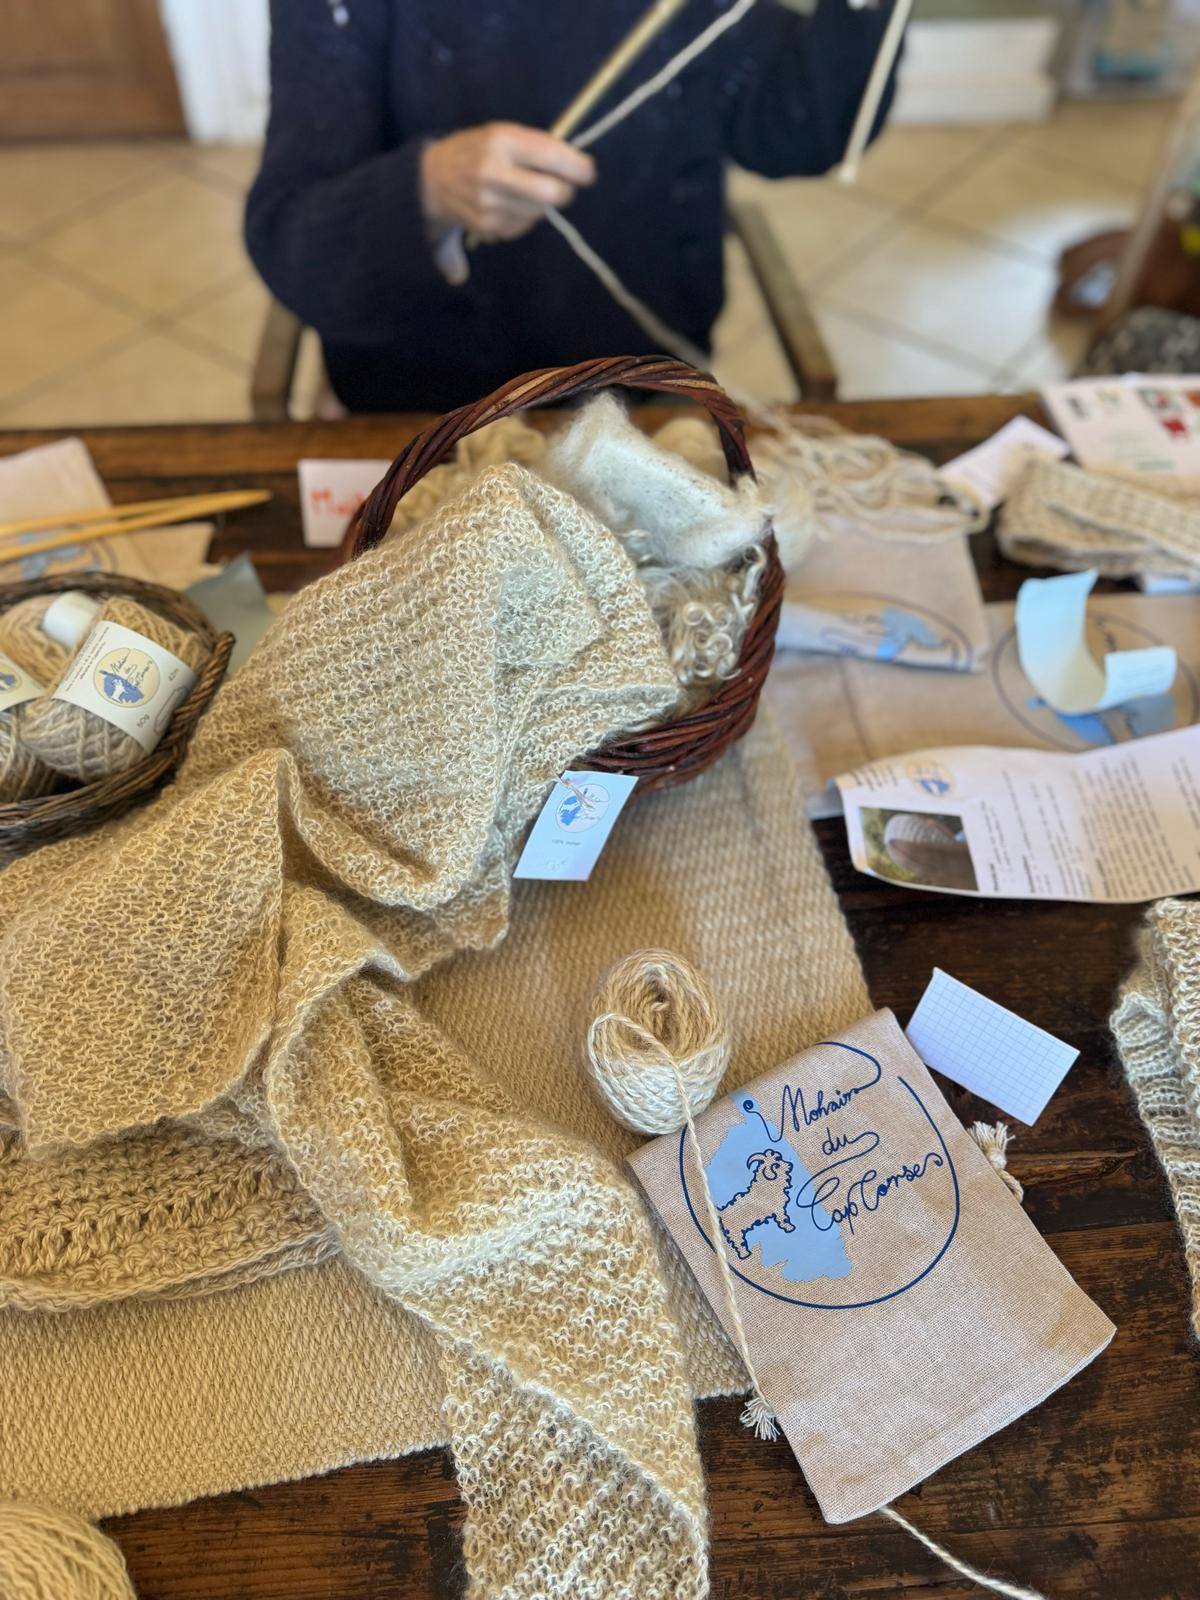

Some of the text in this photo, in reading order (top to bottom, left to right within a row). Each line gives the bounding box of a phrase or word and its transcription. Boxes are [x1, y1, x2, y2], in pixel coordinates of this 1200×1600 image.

[776, 1085, 862, 1140] Mohair
[822, 1127, 858, 1155] du
[811, 1158, 932, 1235] Cap Corse
